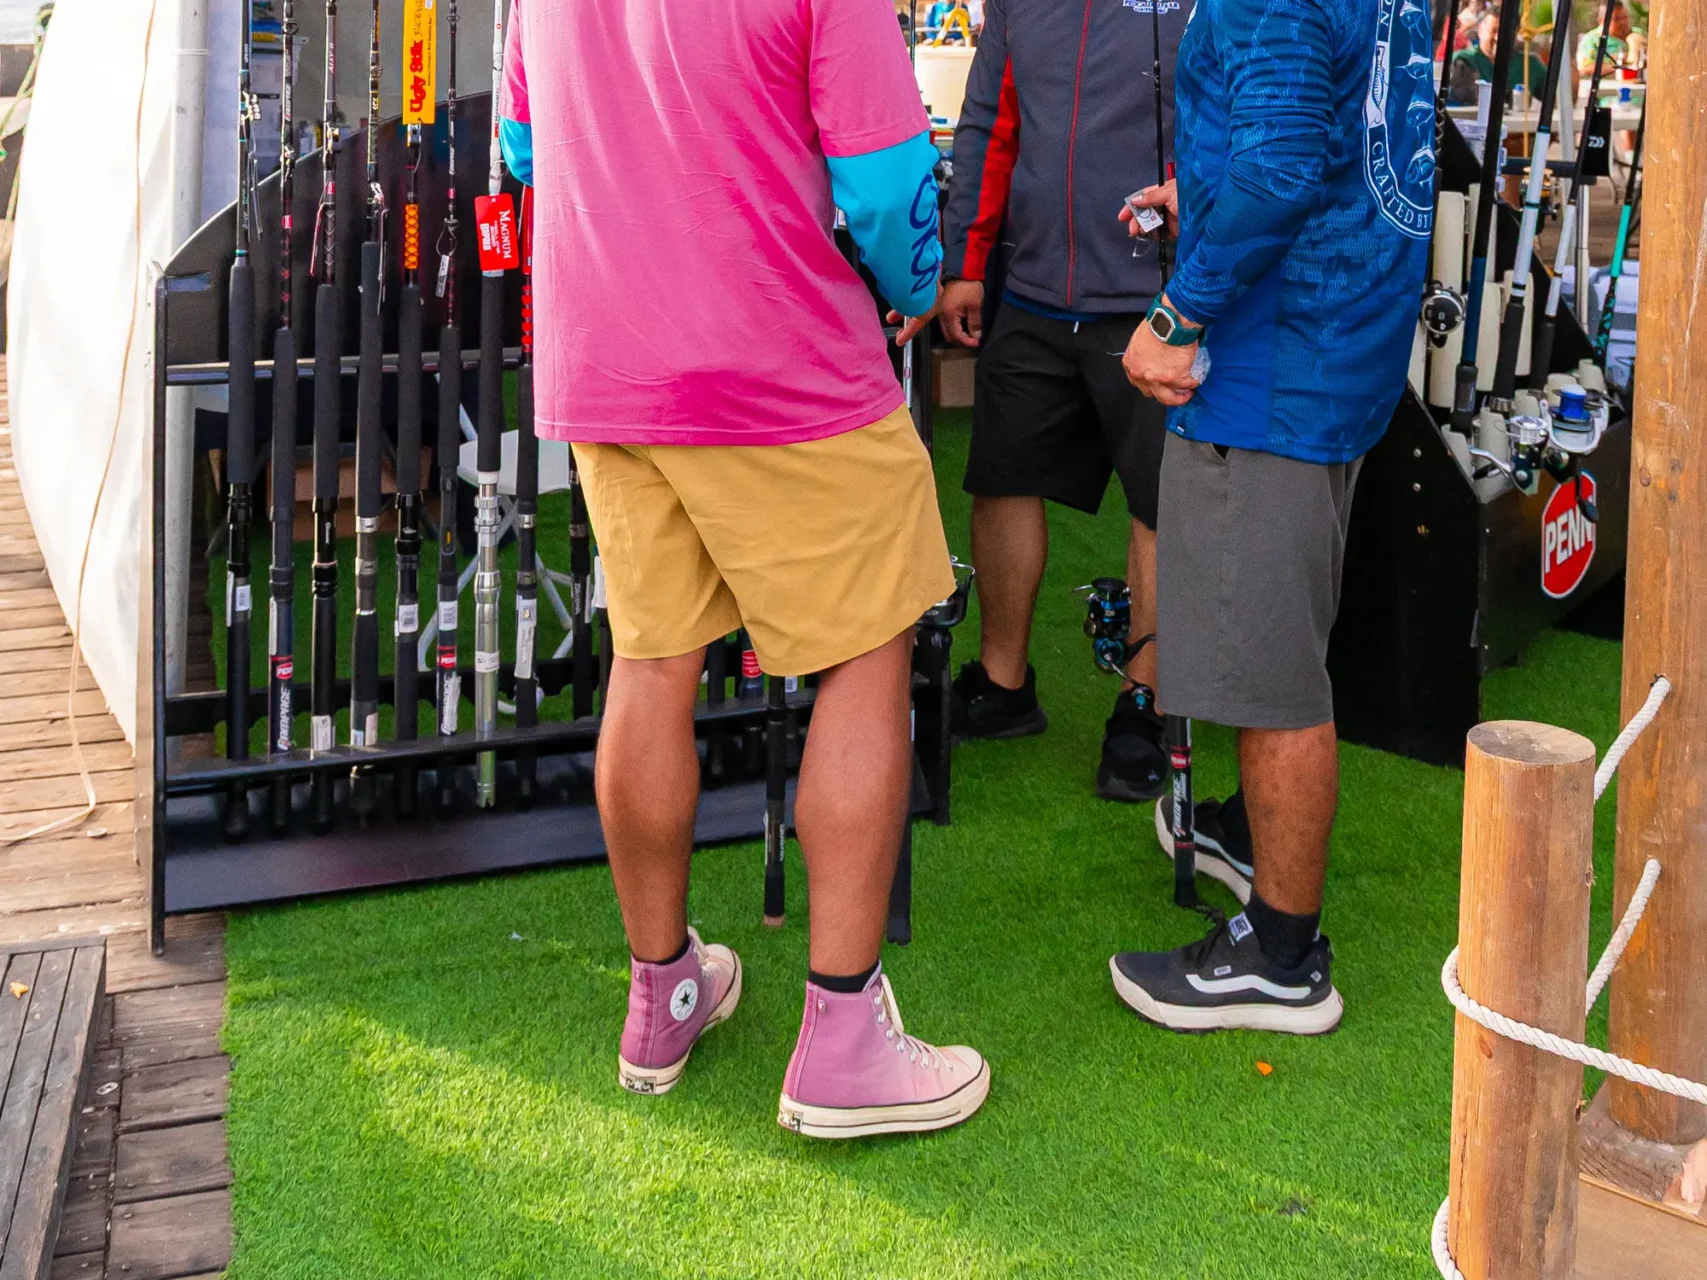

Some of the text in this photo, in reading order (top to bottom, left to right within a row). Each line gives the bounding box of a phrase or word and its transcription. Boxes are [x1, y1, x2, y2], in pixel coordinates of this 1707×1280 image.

[408, 39, 426, 113] Ugly Stik
[1371, 141, 1429, 229] CRAFTED BY
[498, 209, 512, 259] MAGNUM
[1545, 504, 1593, 574] PENN
[276, 684, 292, 751] RAMPAGE
